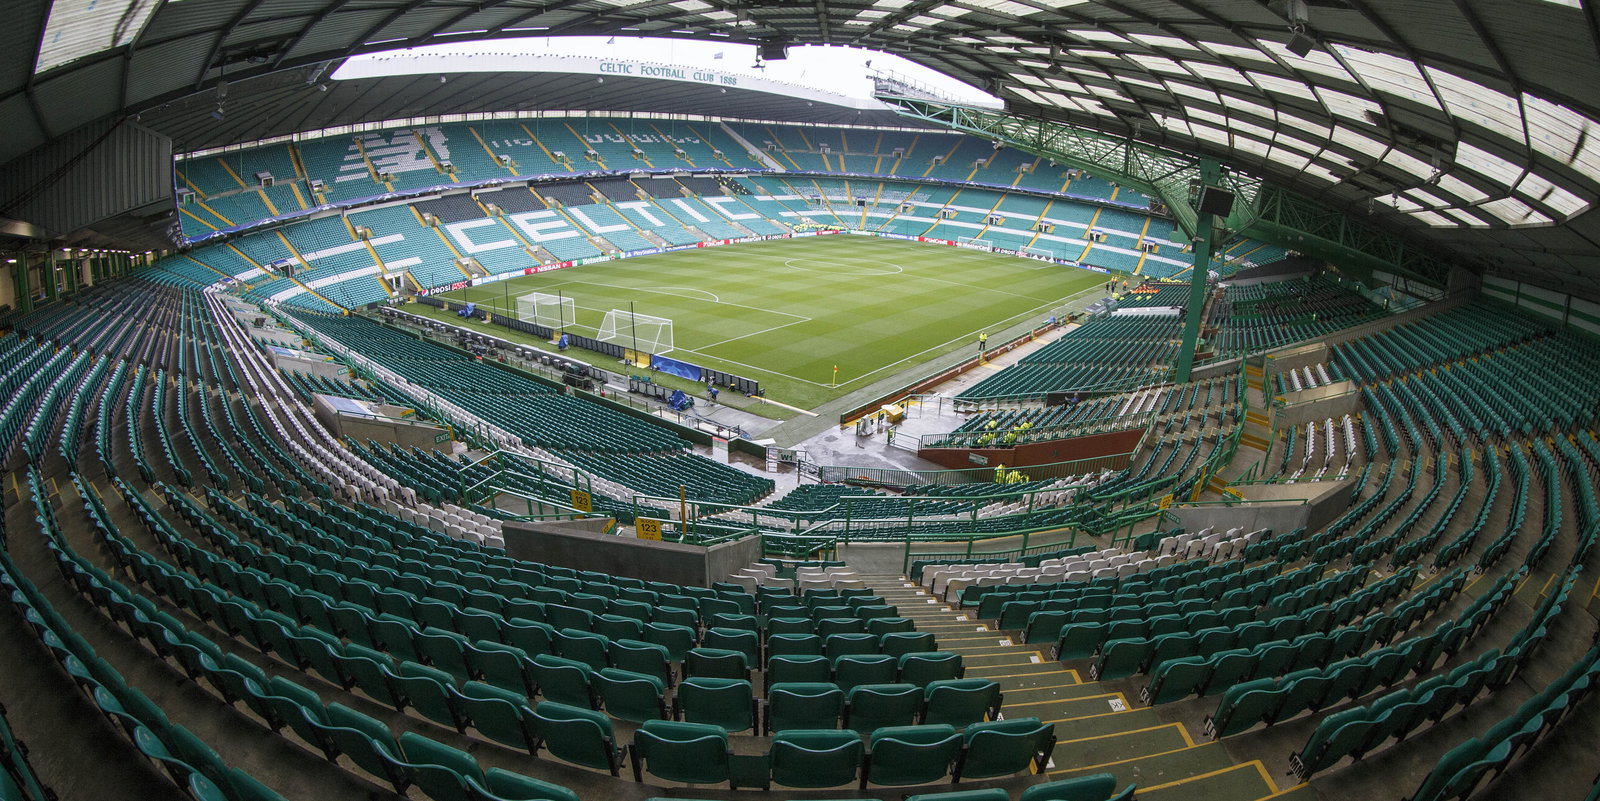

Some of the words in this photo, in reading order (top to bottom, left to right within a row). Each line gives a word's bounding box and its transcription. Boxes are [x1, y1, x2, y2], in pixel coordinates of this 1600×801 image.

[599, 62, 633, 74] CELTIC
[640, 65, 686, 79] FOOTBALL
[693, 71, 714, 82] CLUB
[720, 75, 737, 86] 1888
[445, 196, 762, 254] CELTIC
[633, 248, 657, 256] PlayStation
[537, 263, 561, 273] NISSAN
[430, 284, 451, 296] pepsi
[436, 433, 448, 443] EXIT
[780, 453, 793, 461] W1
[575, 496, 588, 506] 123
[640, 523, 657, 533] 123
